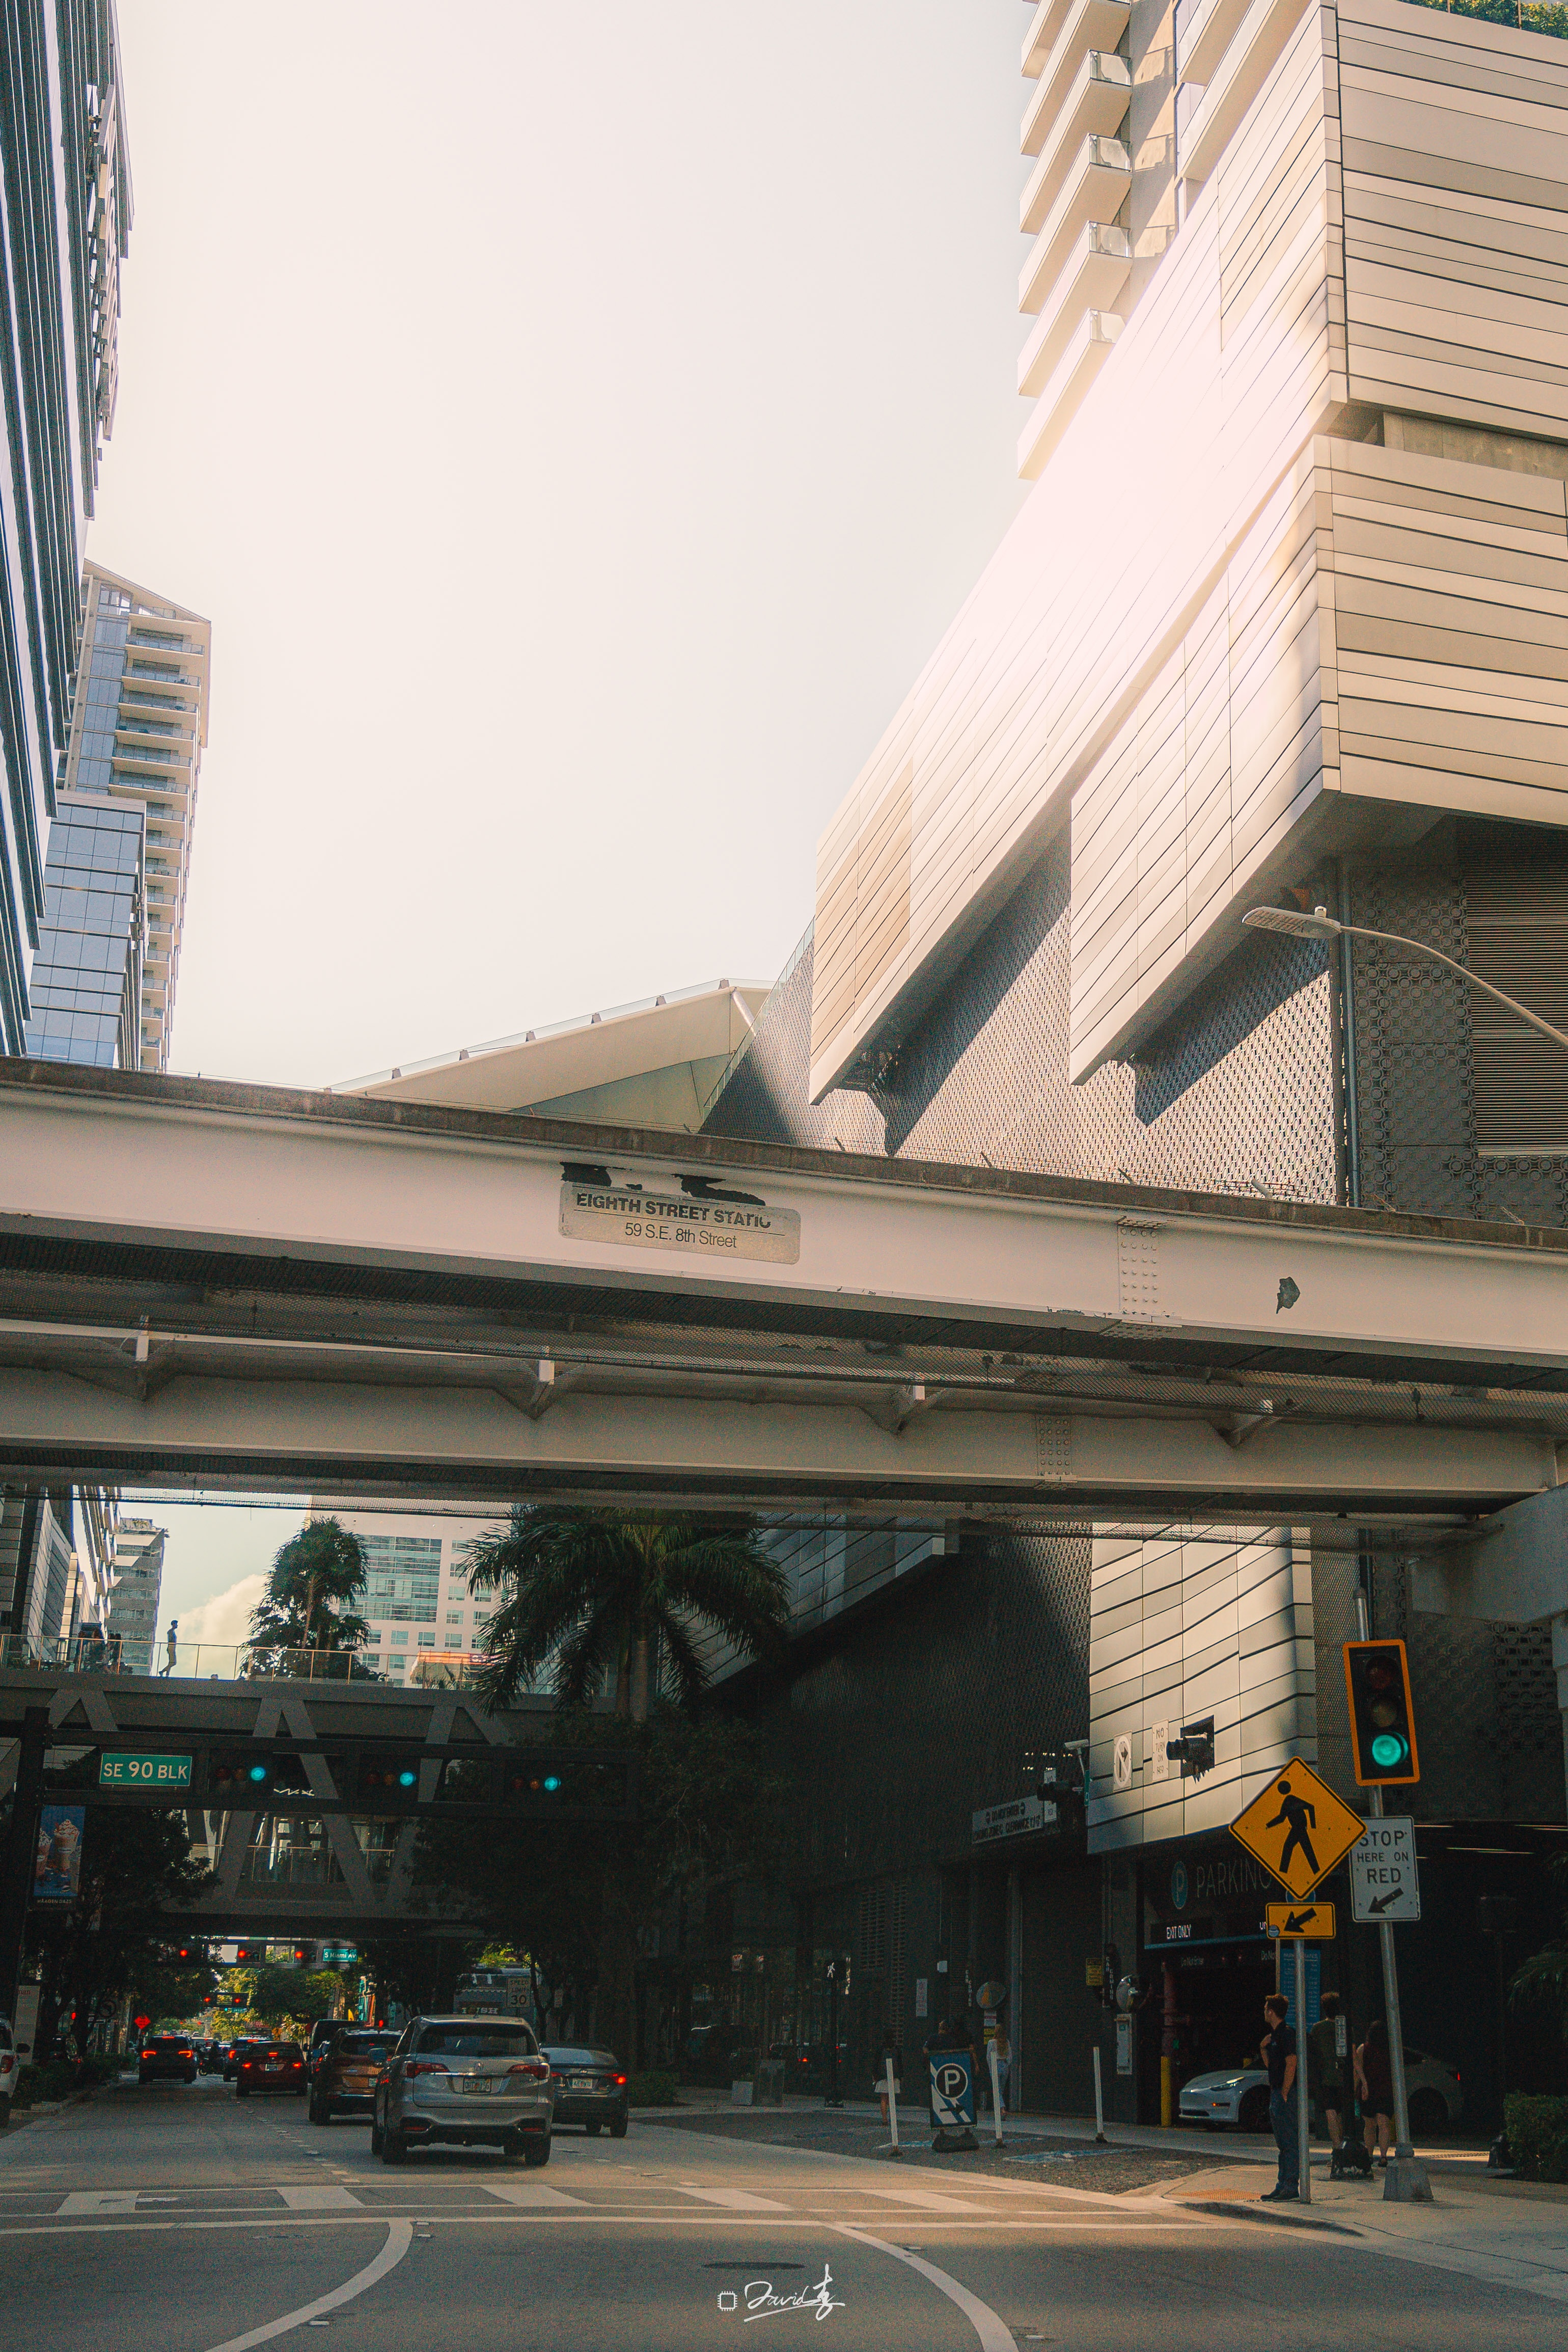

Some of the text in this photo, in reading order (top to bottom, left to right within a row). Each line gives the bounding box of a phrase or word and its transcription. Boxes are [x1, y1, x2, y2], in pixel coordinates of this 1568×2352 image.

[576, 1192, 641, 1214] EIGHTH
[645, 1200, 710, 1221] STREET
[624, 1223, 737, 1248] 59 S.E. 8th Street
[1156, 1728, 1164, 1739] NO
[1156, 1741, 1165, 1752] TURN
[1158, 1754, 1163, 1762] ON
[103, 1761, 188, 1779] SE 90 BLK
[1359, 1830, 1405, 1846] STOP
[1357, 1851, 1409, 1862] HERE ON
[1367, 1867, 1401, 1884] RED
[1166, 1924, 1192, 1939] EXIT ONLY
[511, 1994, 527, 2005] 30
[944, 2069, 960, 2095] P
